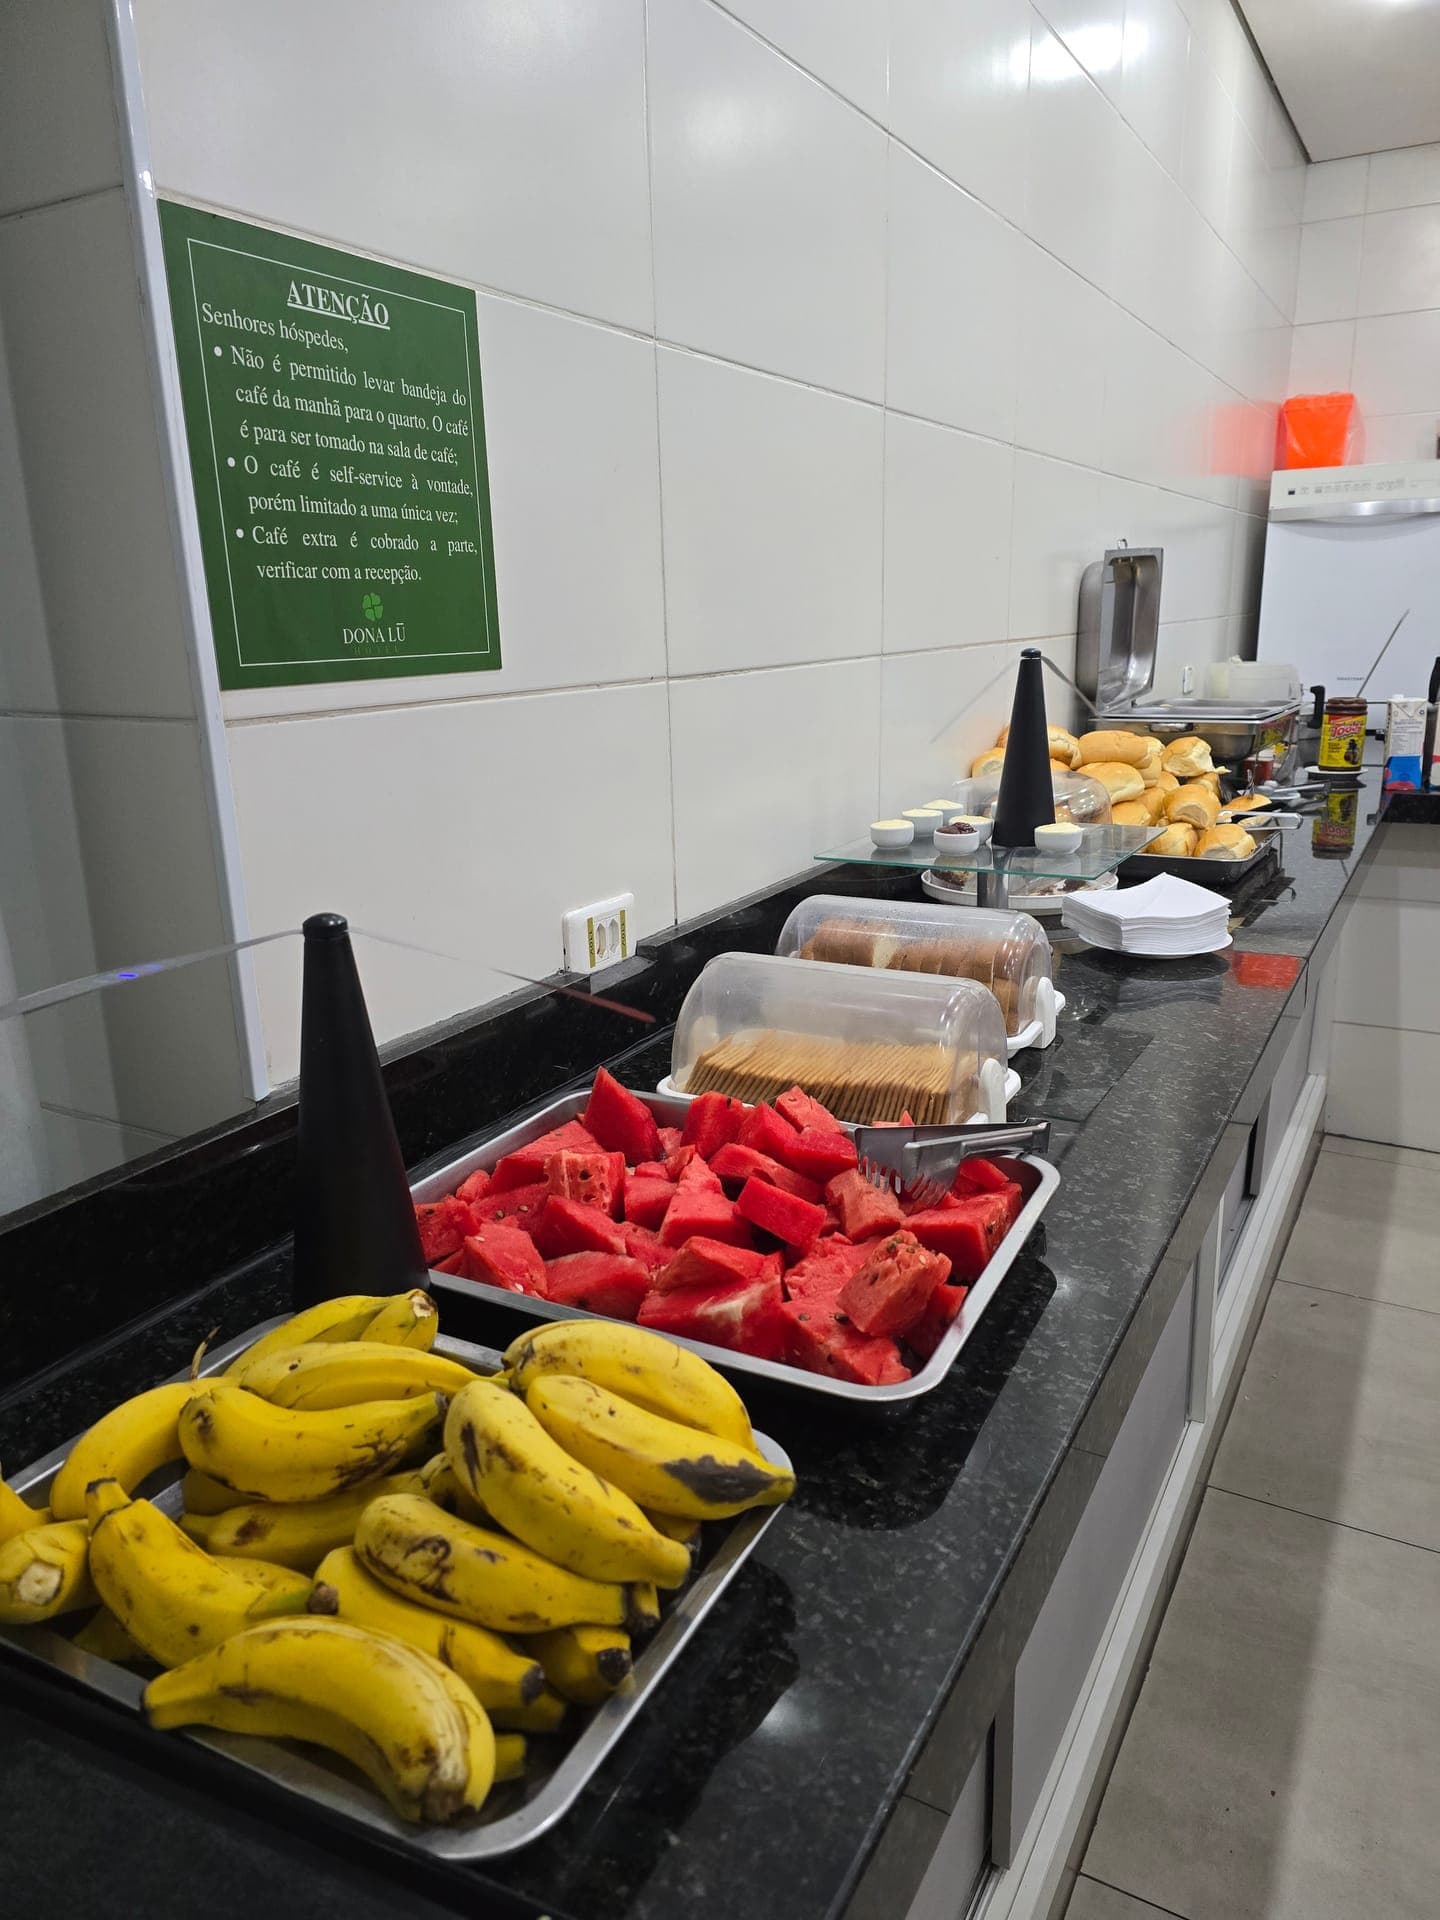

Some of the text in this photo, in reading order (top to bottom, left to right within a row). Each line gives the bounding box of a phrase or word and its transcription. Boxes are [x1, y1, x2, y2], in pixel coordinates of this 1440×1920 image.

[287, 280, 390, 324] ATENÇÃO
[202, 303, 349, 353] Senhores hóspedes,
[232, 346, 466, 406] Não é permitido levar bandeja do
[235, 385, 468, 435] café da manhã para o quarto. O café
[240, 420, 458, 466] é para ser tomado na sala de café;
[244, 456, 473, 497] O café é self-service à vontade,
[248, 493, 296, 514] porém
[300, 495, 356, 516] limitado
[360, 504, 368, 516] a
[372, 504, 398, 519] uma
[401, 503, 432, 521] única
[252, 526, 477, 556] Café extra é cobrado a parte,
[256, 561, 422, 584] verificar com a recepção.
[343, 627, 384, 644] DONA
